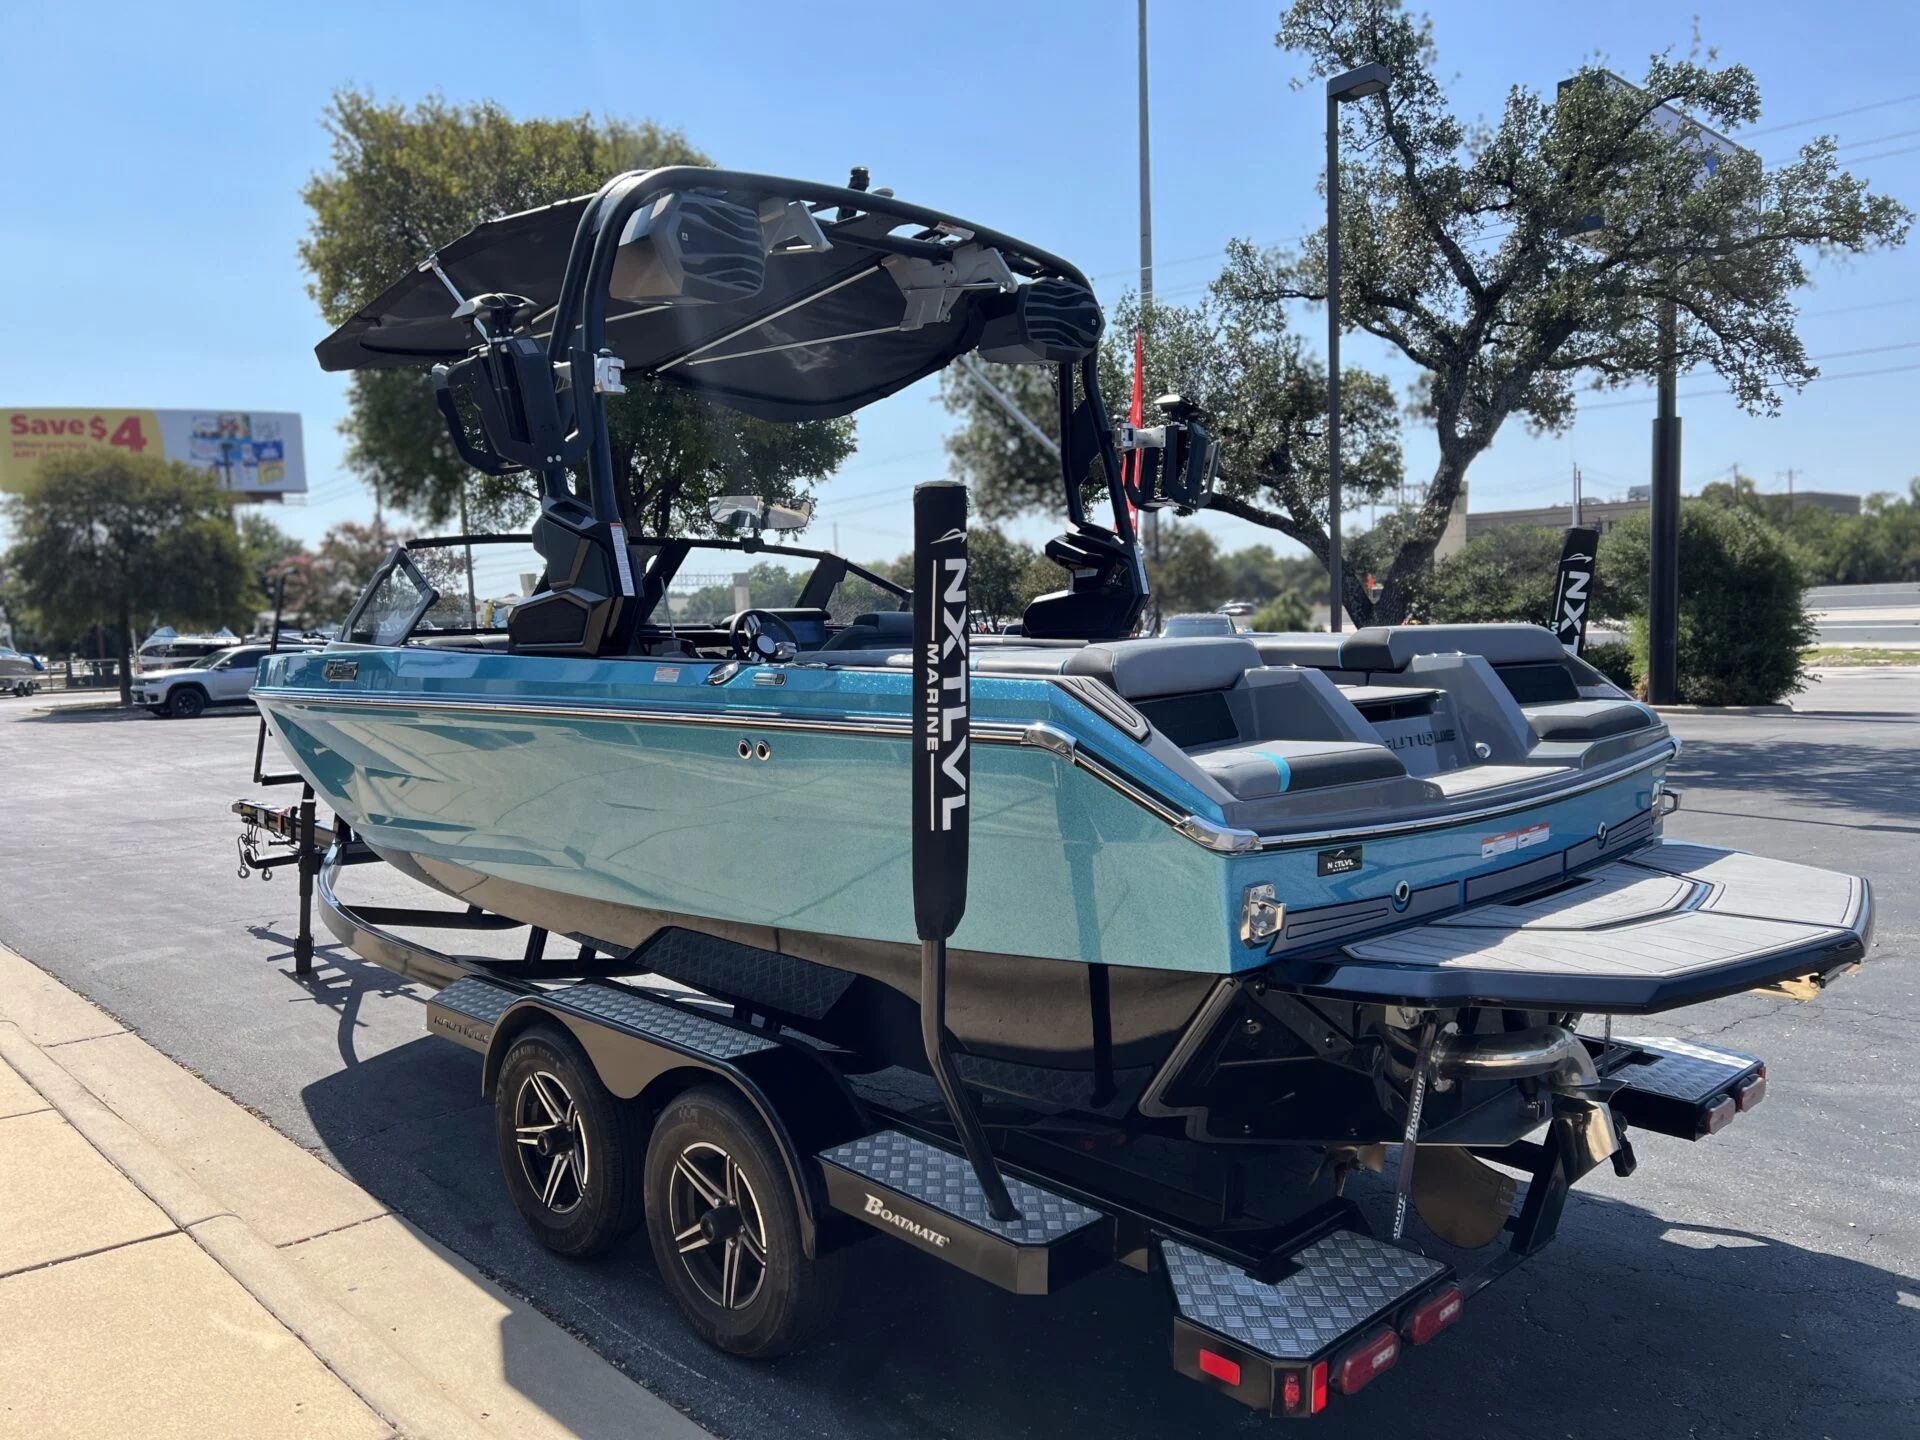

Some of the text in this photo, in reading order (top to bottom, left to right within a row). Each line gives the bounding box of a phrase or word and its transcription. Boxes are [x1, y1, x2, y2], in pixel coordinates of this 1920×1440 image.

[10, 414, 147, 453] Save $4
[1560, 571, 1591, 657] NXT
[926, 643, 939, 751] MARINE
[942, 558, 967, 831] NXTLVL
[434, 1016, 490, 1044] NAUTIQUE
[864, 1193, 946, 1247] BOATMATE
